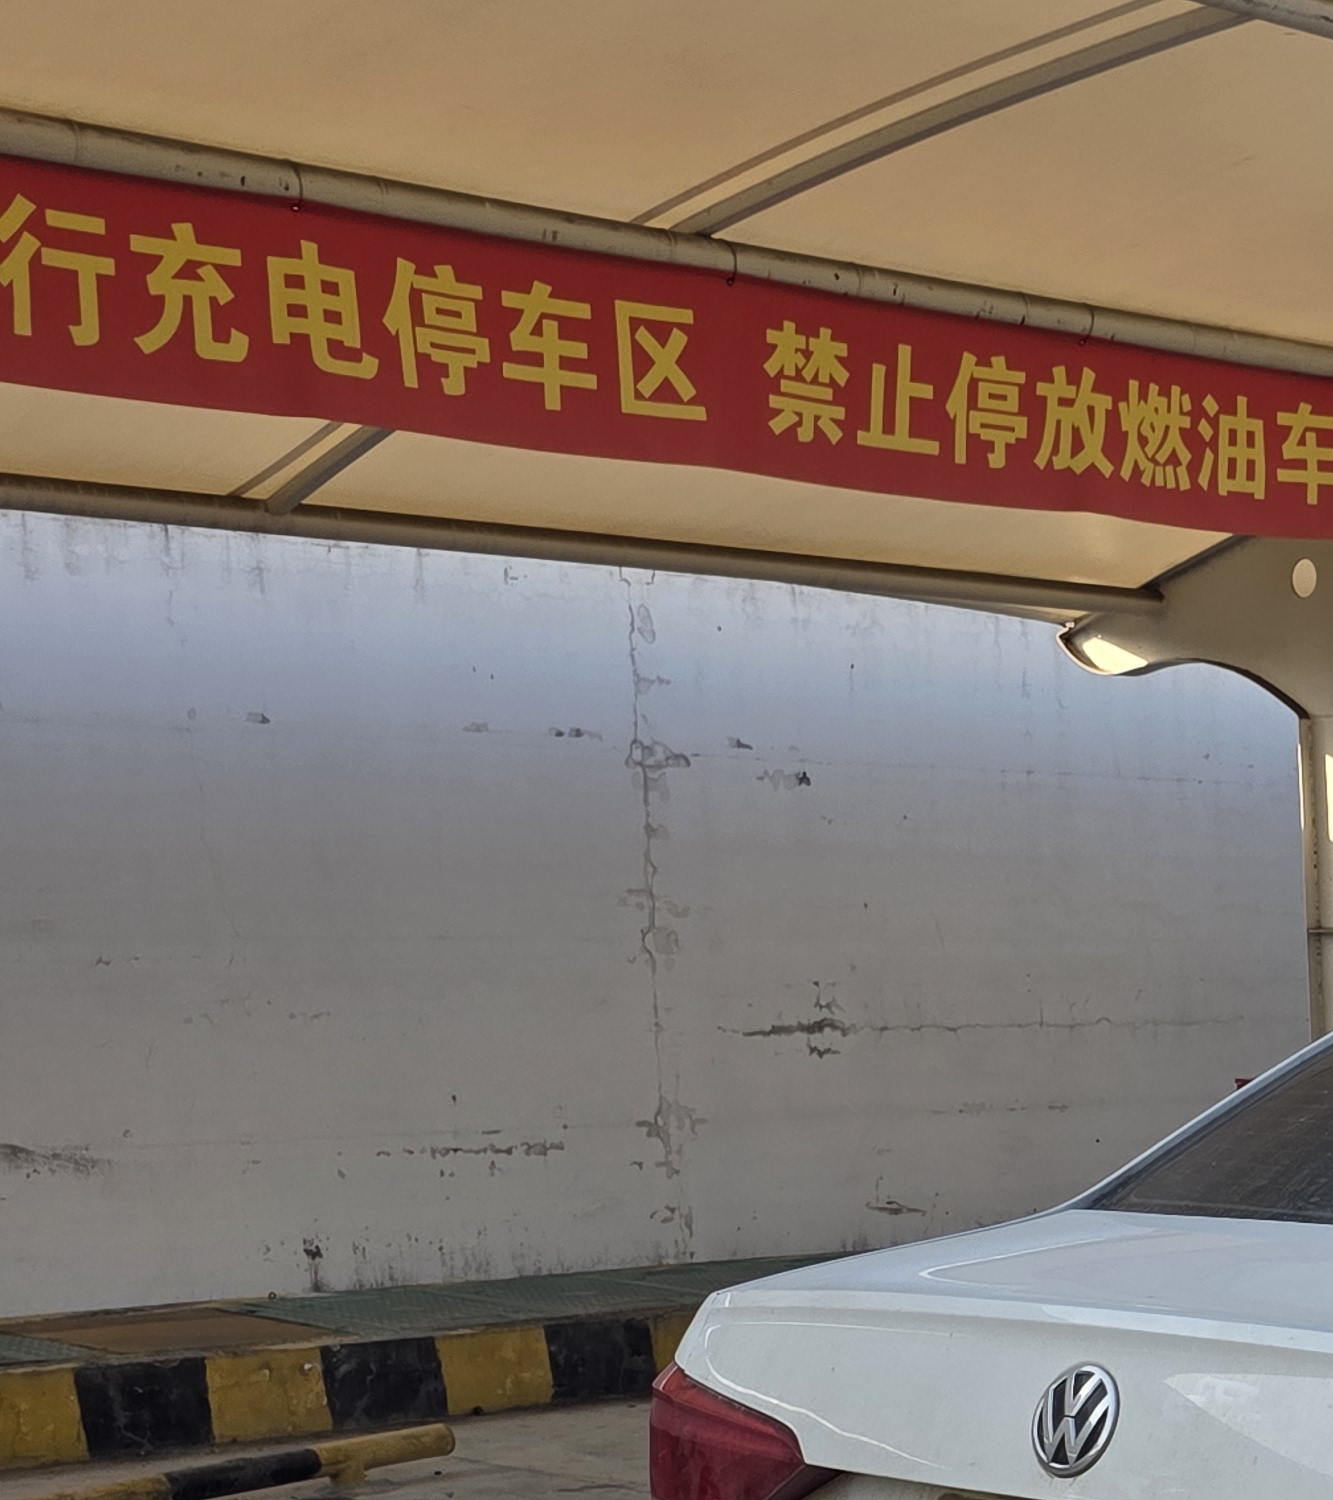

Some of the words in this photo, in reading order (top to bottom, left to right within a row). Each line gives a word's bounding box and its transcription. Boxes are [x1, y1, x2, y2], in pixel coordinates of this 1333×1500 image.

[0, 193, 708, 422] 行充电停车区
